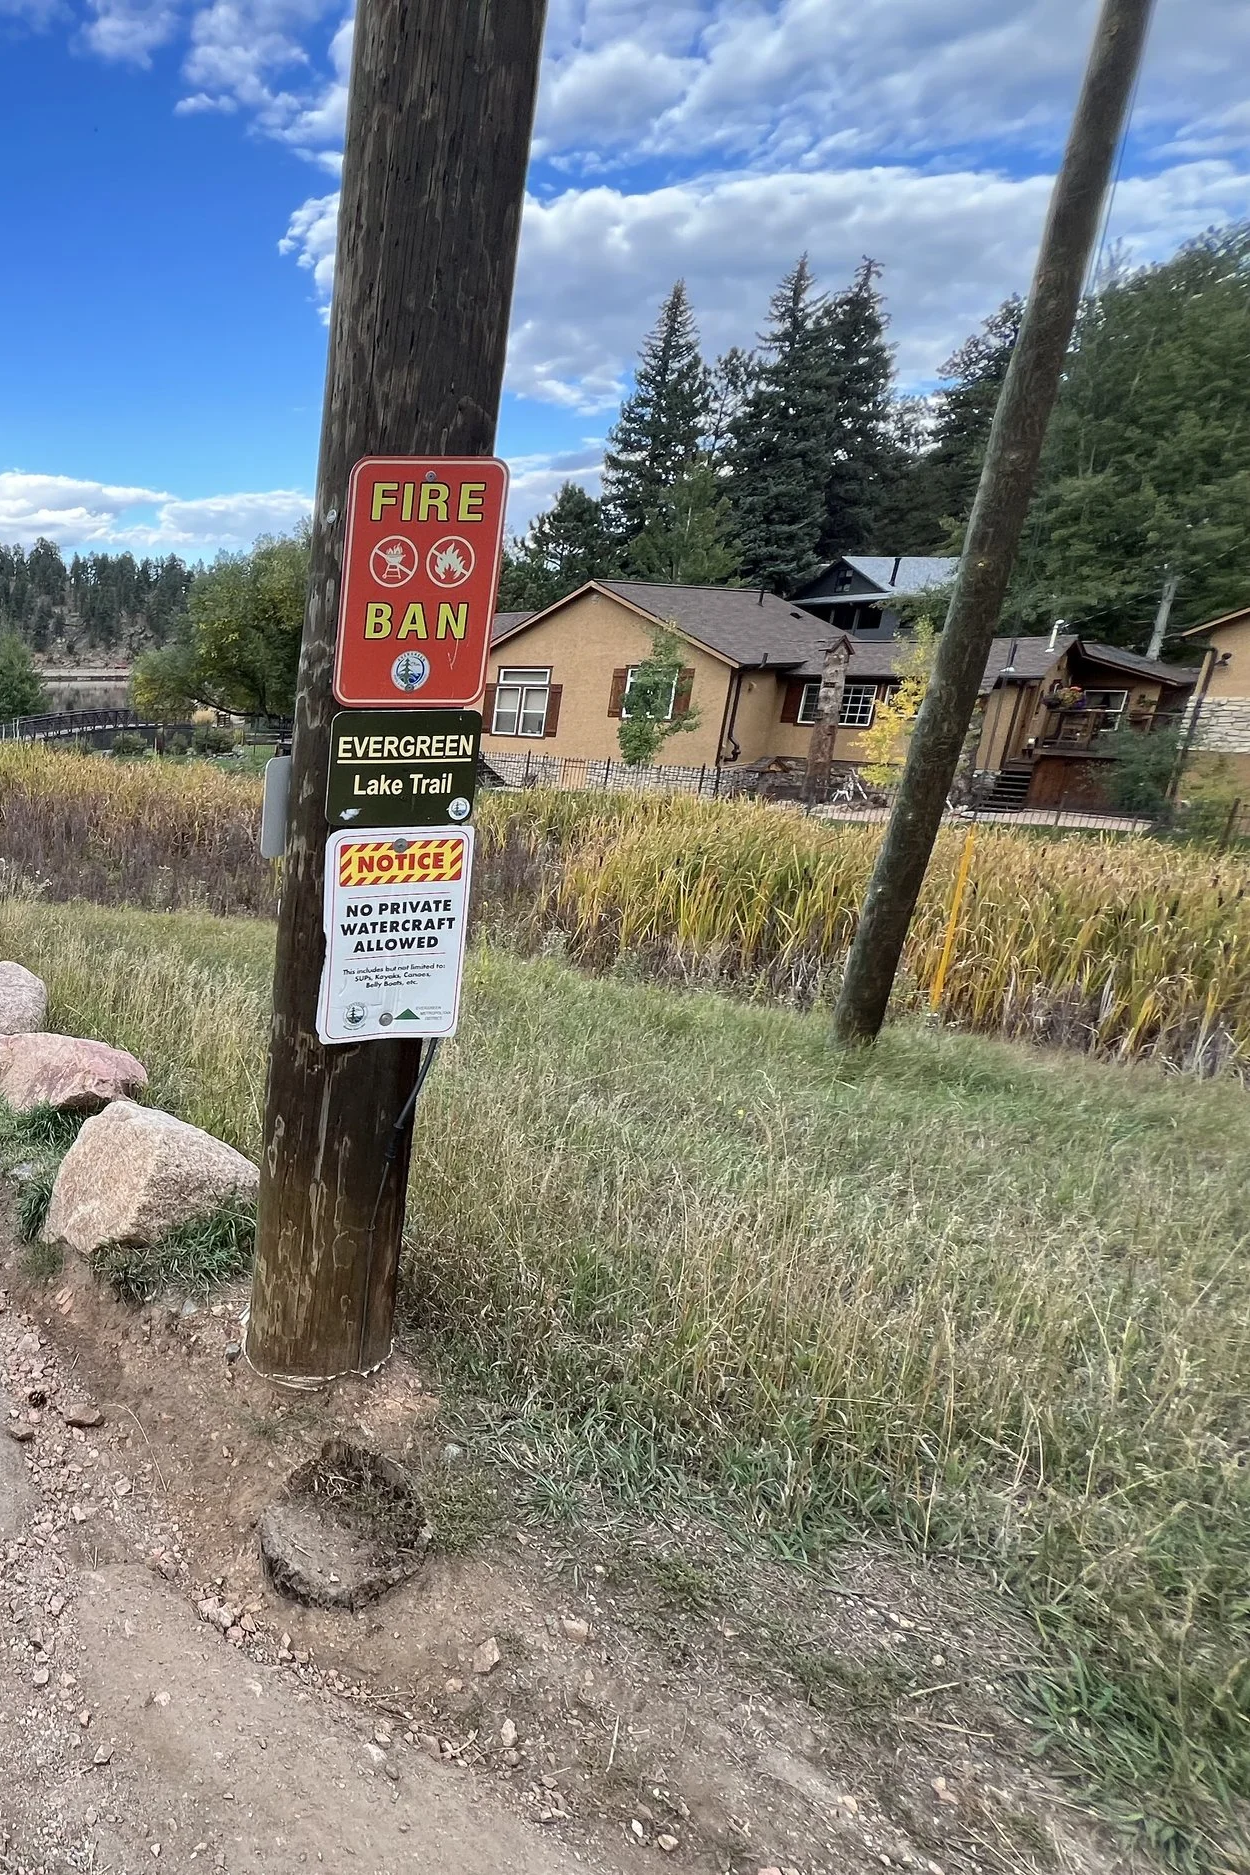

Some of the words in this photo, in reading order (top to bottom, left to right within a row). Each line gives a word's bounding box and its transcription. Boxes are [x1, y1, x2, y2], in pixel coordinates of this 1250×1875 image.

[370, 481, 486, 522] FIRE
[364, 602, 468, 640] BAN
[338, 734, 474, 758] EVERGREEN
[354, 774, 403, 795] Lake
[410, 773, 452, 794] Trail
[357, 852, 444, 874] NOTICE
[346, 904, 373, 918] NO
[378, 900, 452, 915] PRIVATE
[340, 917, 456, 936] WATERCRAFT
[353, 936, 438, 954] ALLOWED
